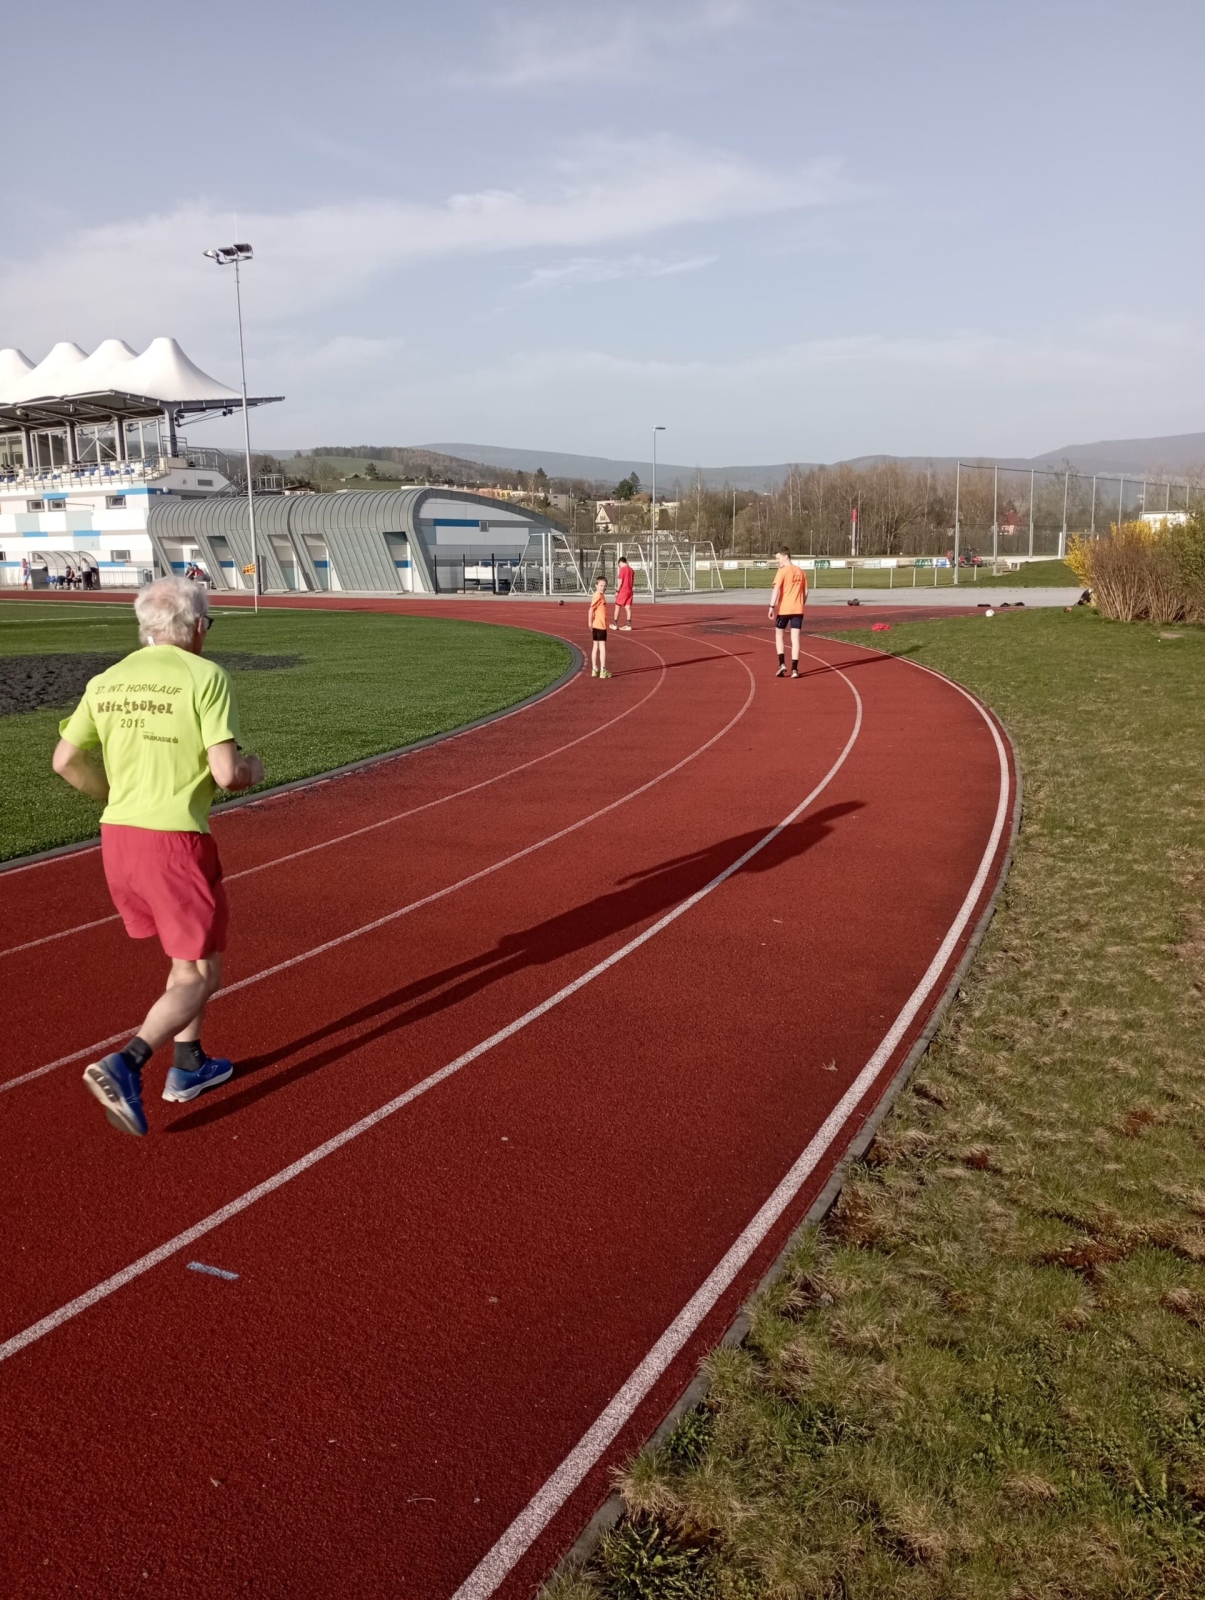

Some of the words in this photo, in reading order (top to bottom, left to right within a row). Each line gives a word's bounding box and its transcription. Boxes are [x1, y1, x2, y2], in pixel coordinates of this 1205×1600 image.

[107, 684, 124, 693] INT.
[126, 684, 182, 695] HORNLAUF
[120, 718, 146, 728] 2015
